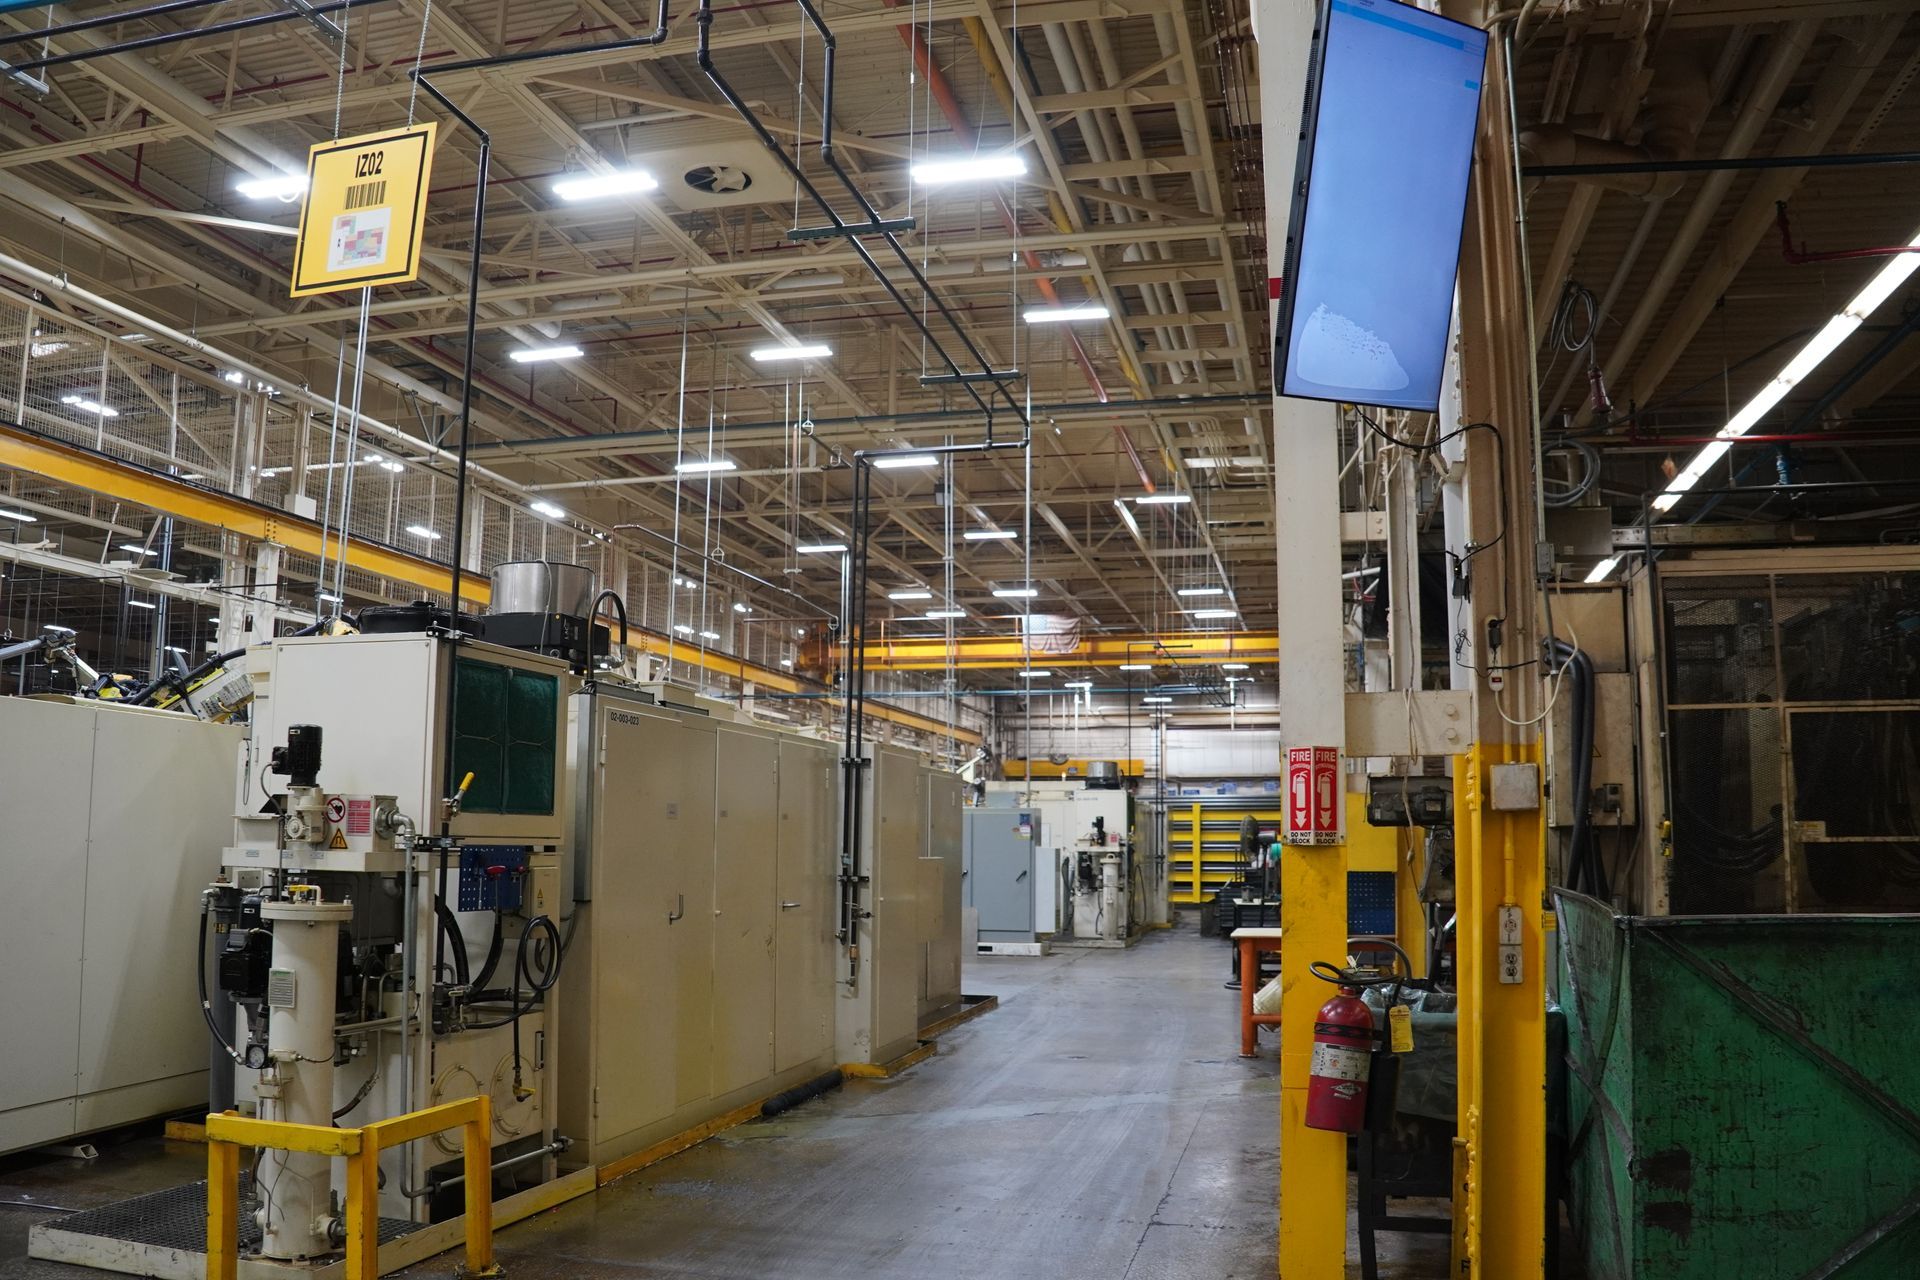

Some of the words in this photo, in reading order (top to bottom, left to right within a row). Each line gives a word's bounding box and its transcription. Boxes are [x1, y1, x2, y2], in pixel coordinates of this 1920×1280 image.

[355, 151, 384, 178] IZ02
[1291, 751, 1310, 761] FIRE
[1315, 752, 1335, 761] FIRE
